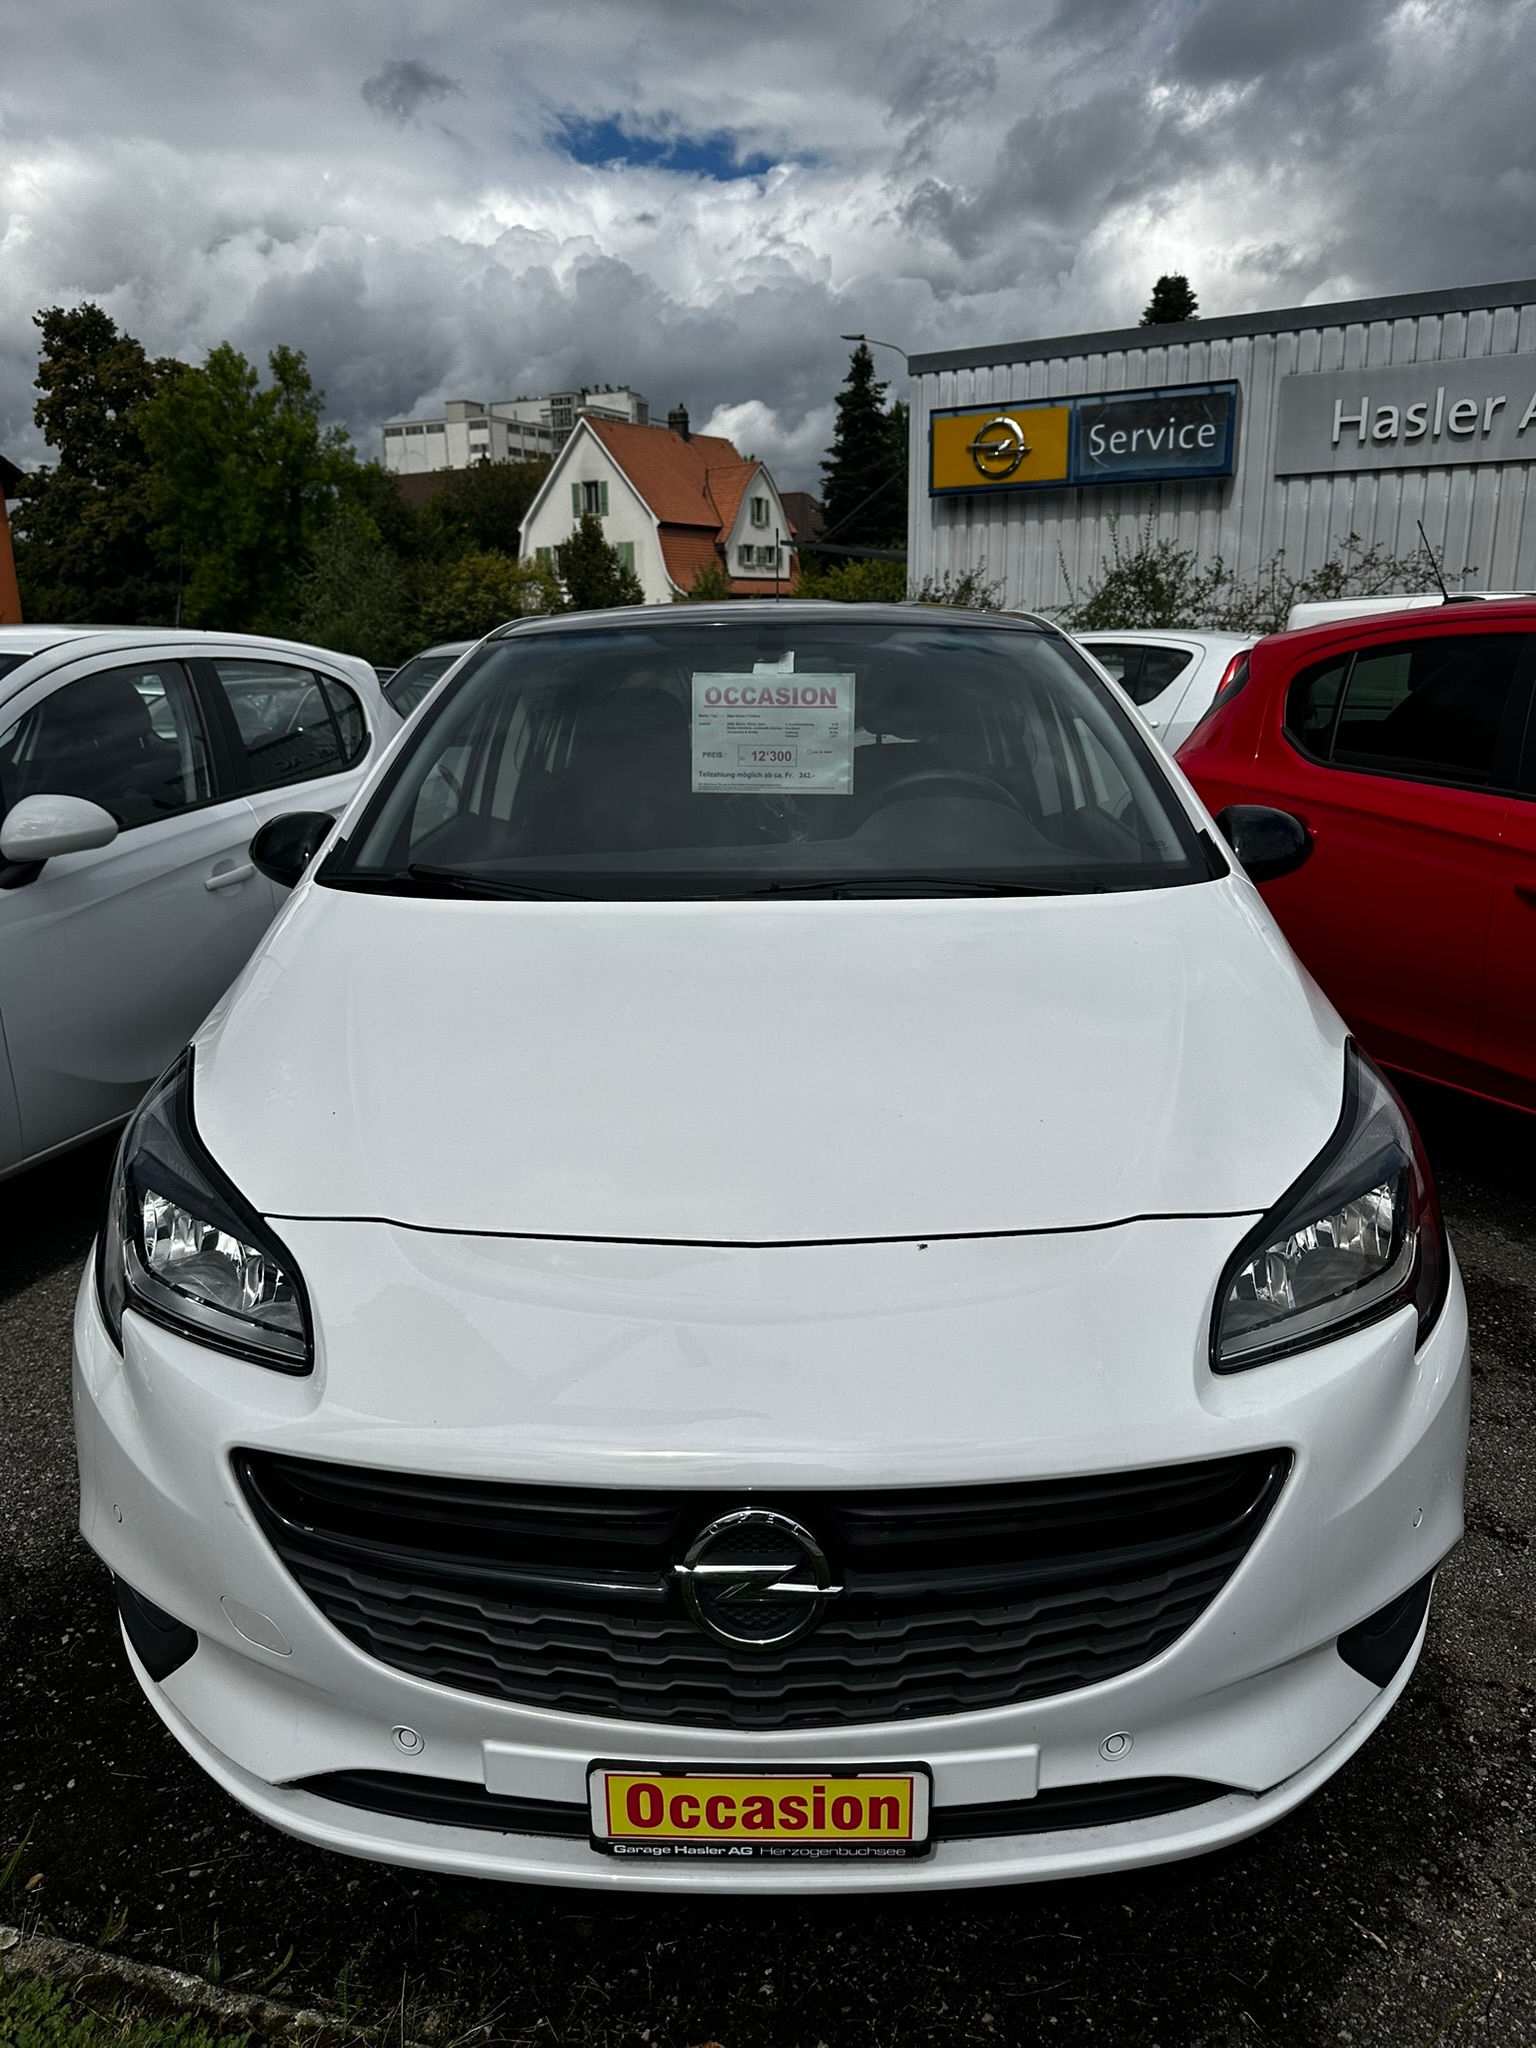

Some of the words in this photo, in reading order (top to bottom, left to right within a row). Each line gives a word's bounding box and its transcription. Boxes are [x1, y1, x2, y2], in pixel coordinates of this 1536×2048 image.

[1332, 386, 1507, 442] Hasler
[1089, 416, 1216, 456] Service
[704, 687, 837, 705] OCCASION
[698, 770, 736, 779] Teilzahlung
[737, 770, 763, 779] möglich
[625, 1783, 901, 1830] Occasion
[613, 1844, 672, 1856] Garage
[674, 1845, 726, 1855] Hasler
[728, 1846, 753, 1856] AG
[760, 1846, 906, 1858] Herzogenbuchsee
